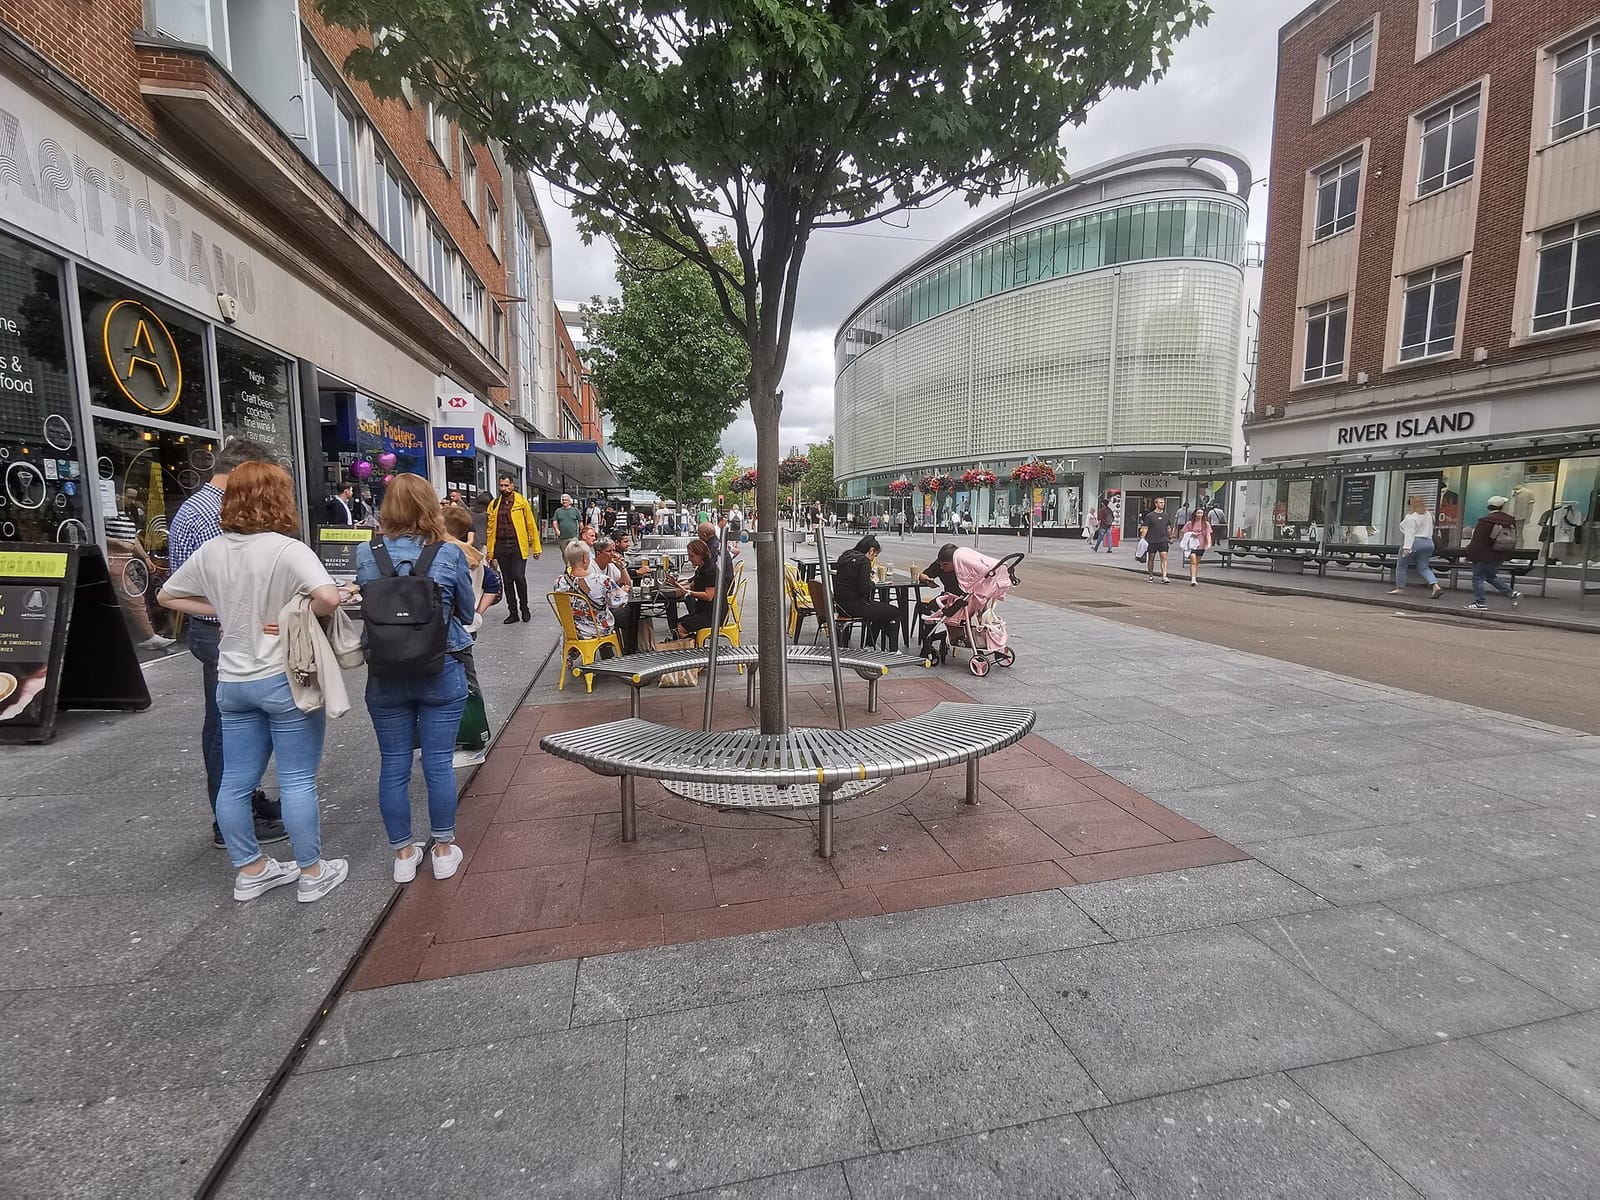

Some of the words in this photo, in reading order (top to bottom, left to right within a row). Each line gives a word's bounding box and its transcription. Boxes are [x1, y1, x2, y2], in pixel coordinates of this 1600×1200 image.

[248, 370, 266, 385] Night
[241, 390, 257, 405] Craft
[1338, 422, 1388, 444] RIVER
[1396, 411, 1475, 438] ISLAND
[442, 433, 464, 441] Card
[437, 441, 470, 450] Factory
[1140, 478, 1169, 488] NEXT
